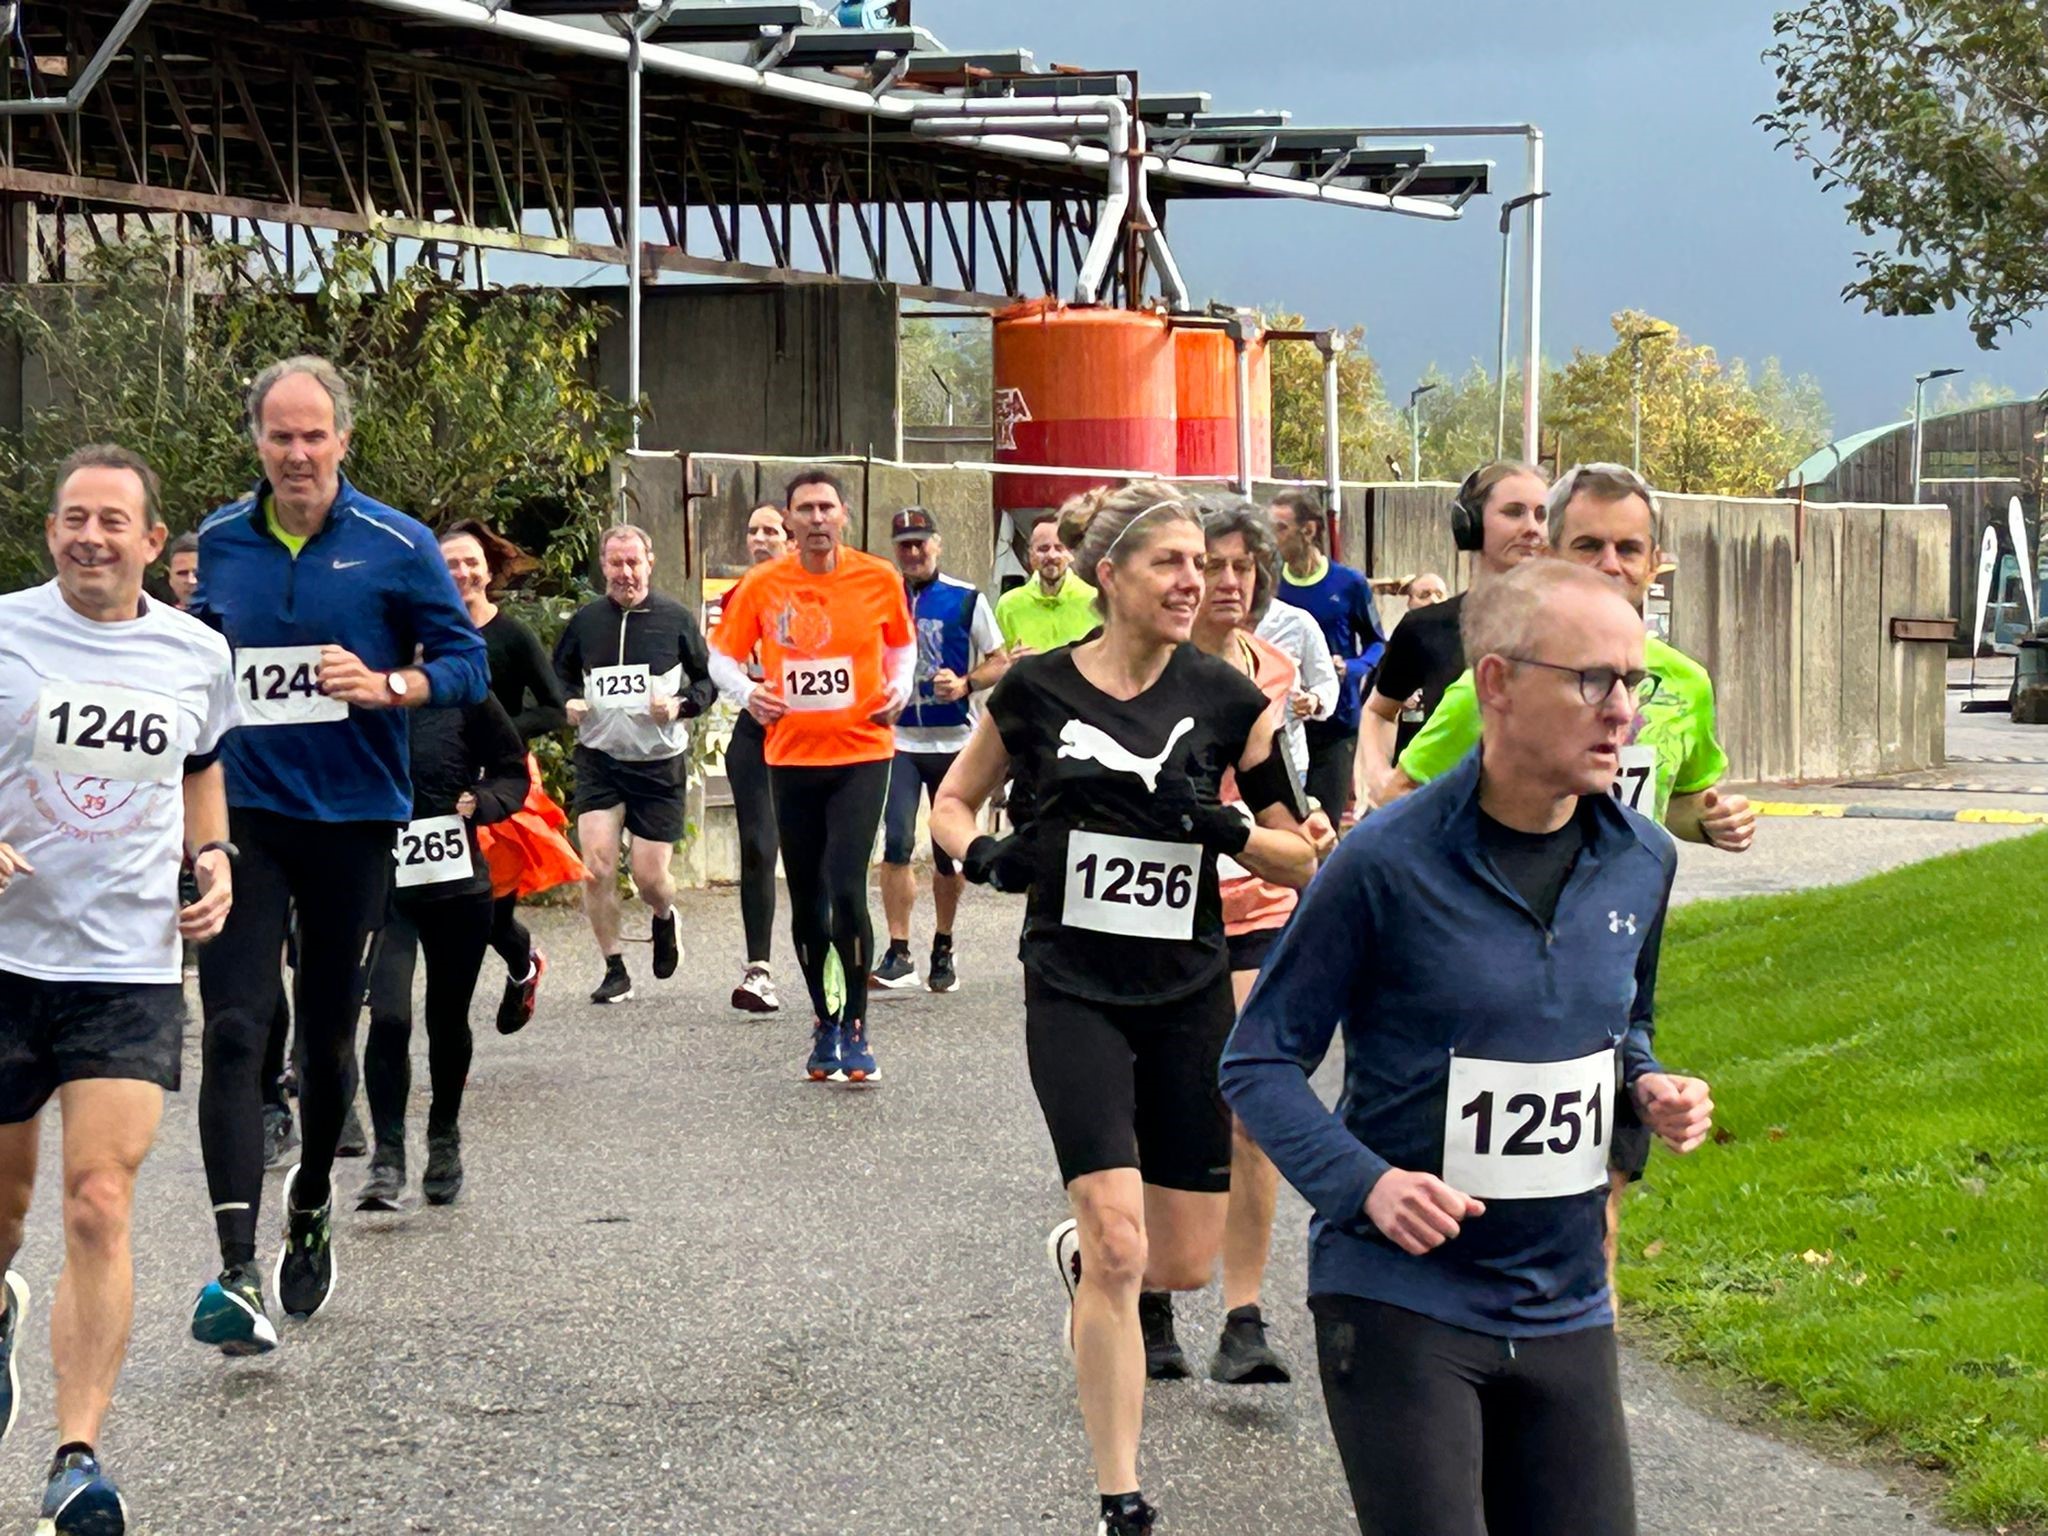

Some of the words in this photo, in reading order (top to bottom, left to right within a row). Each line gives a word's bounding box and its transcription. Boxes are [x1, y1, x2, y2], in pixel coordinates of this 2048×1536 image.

[596, 674, 647, 697] 1233
[786, 666, 850, 697] 1239
[49, 701, 169, 756] 1246
[397, 827, 464, 867] 265
[1075, 853, 1192, 910] 1256
[1460, 1082, 1604, 1157] 1251
